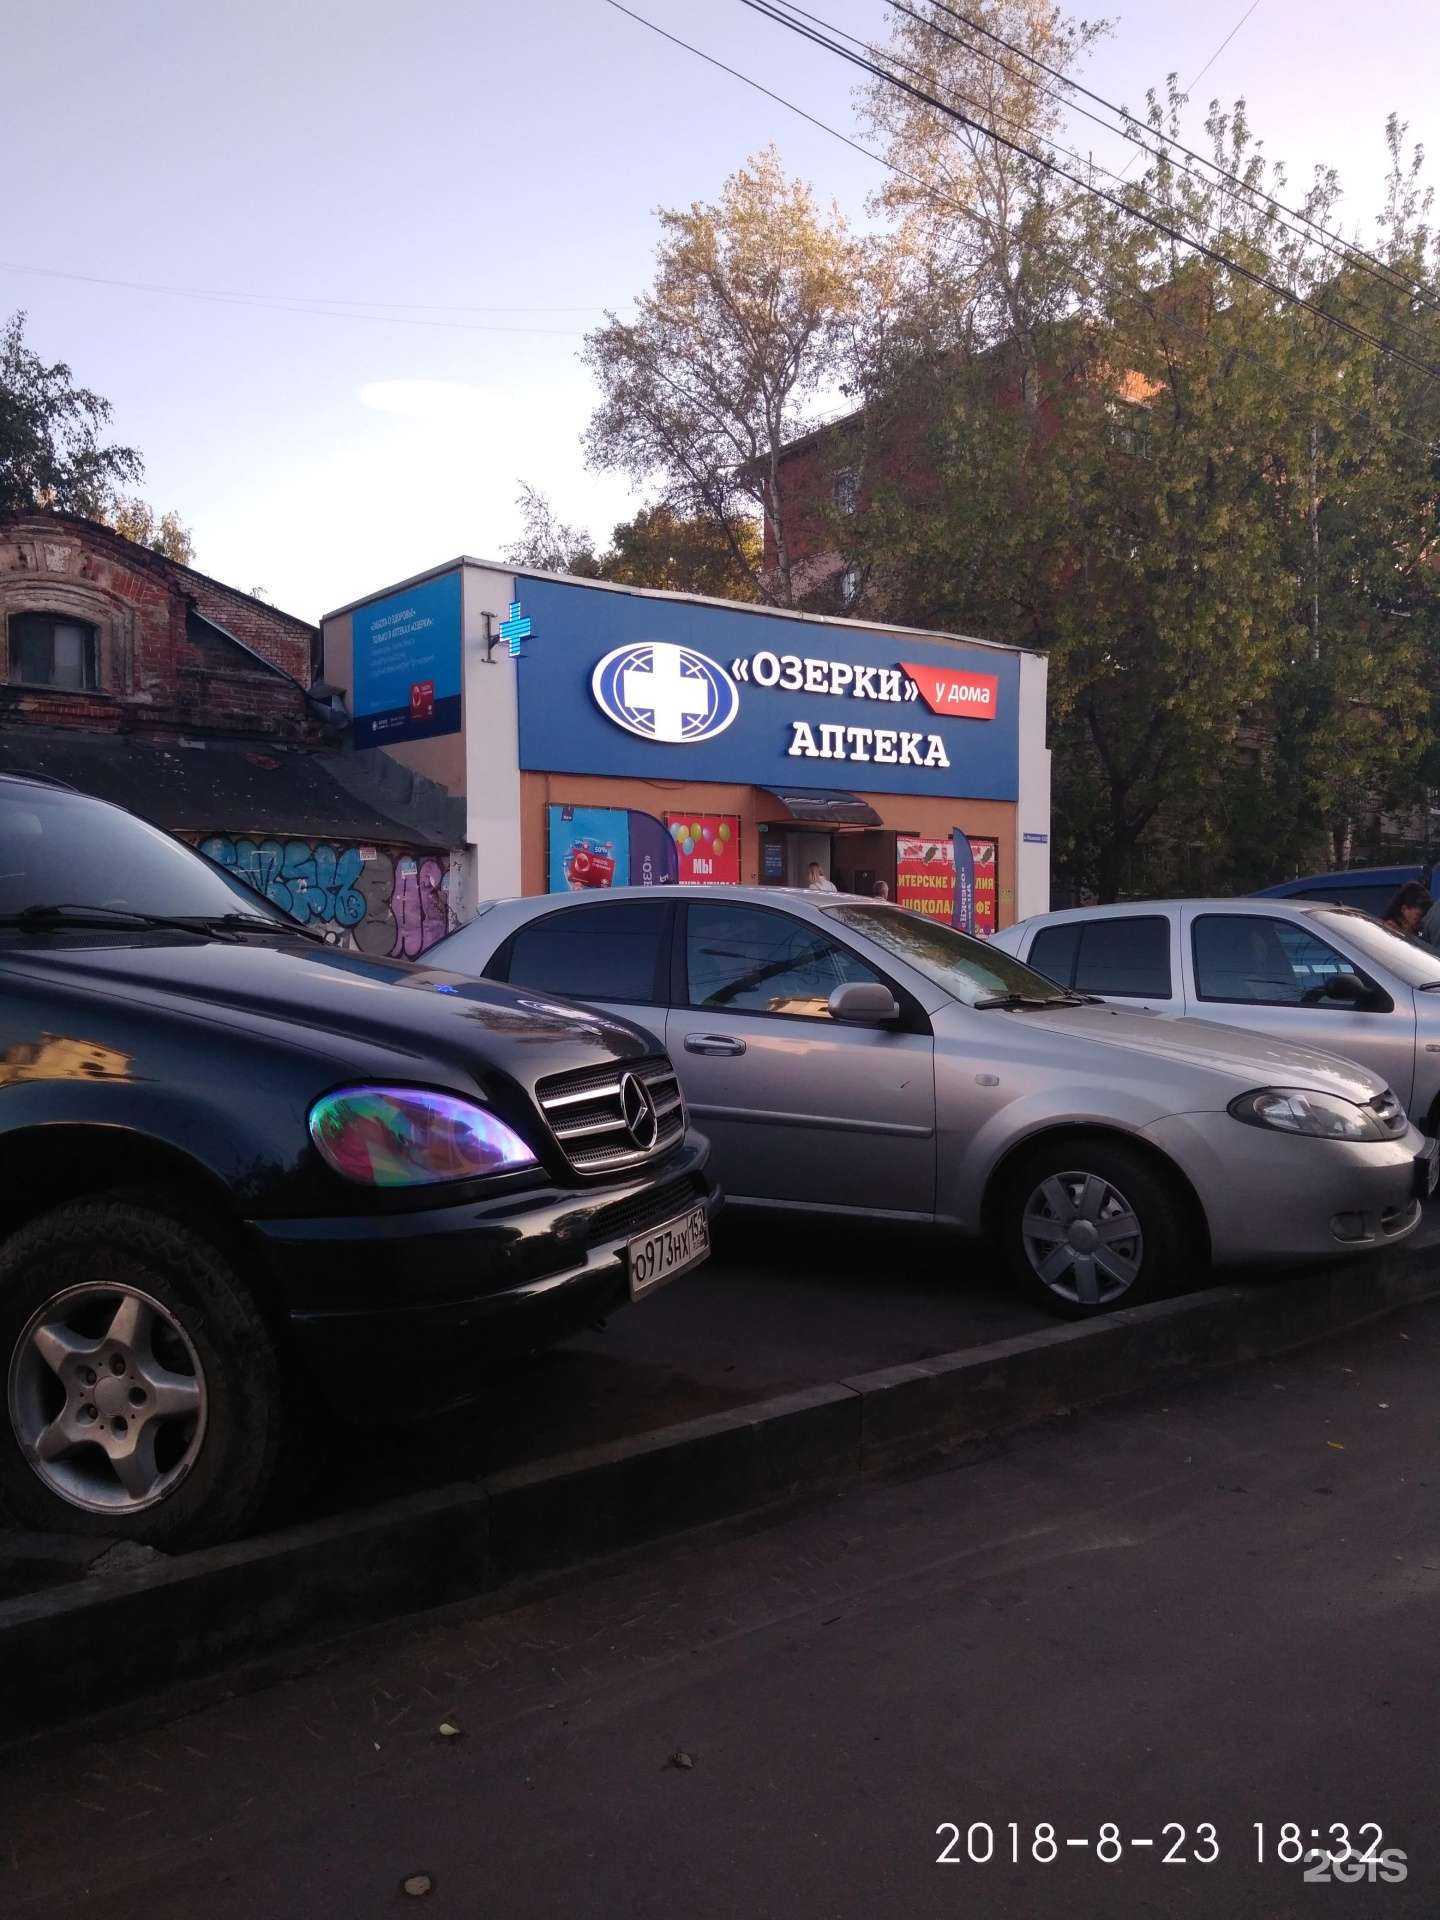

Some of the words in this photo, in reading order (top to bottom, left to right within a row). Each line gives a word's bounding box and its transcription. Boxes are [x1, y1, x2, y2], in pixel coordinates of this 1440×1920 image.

[731, 651, 919, 702] «ОЗЕРКИ»
[934, 681, 944, 703] у
[947, 682, 991, 704] дома
[788, 721, 951, 768] АПТЕКА
[692, 858, 713, 874] МЫ
[897, 874, 948, 889] ИТЕРСКИЕ
[902, 898, 954, 914] ШОКОЛА
